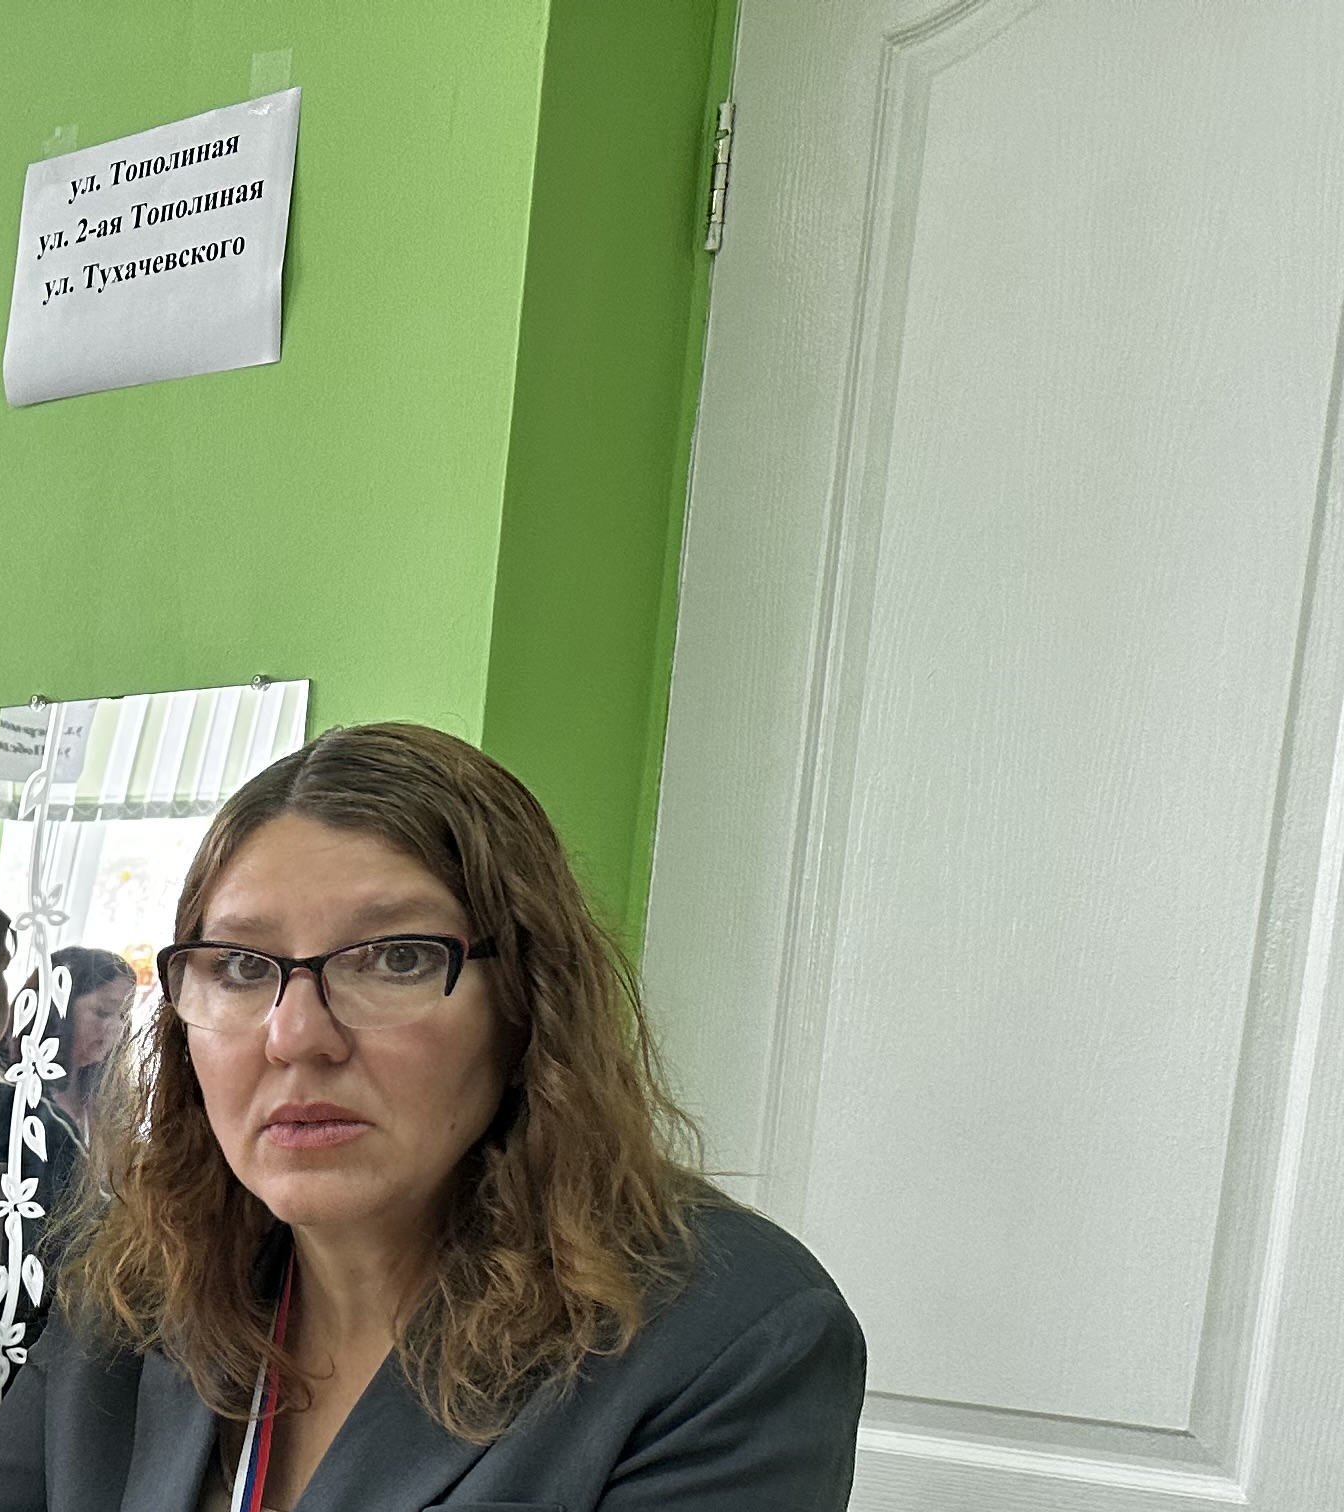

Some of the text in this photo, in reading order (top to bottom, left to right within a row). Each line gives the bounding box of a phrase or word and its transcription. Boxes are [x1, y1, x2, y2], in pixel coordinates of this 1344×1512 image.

[69, 134, 241, 203] ул. Тополиная
[38, 179, 266, 260] ул. 2-ая Тополиная
[44, 234, 246, 304] ул. Тухачевского
